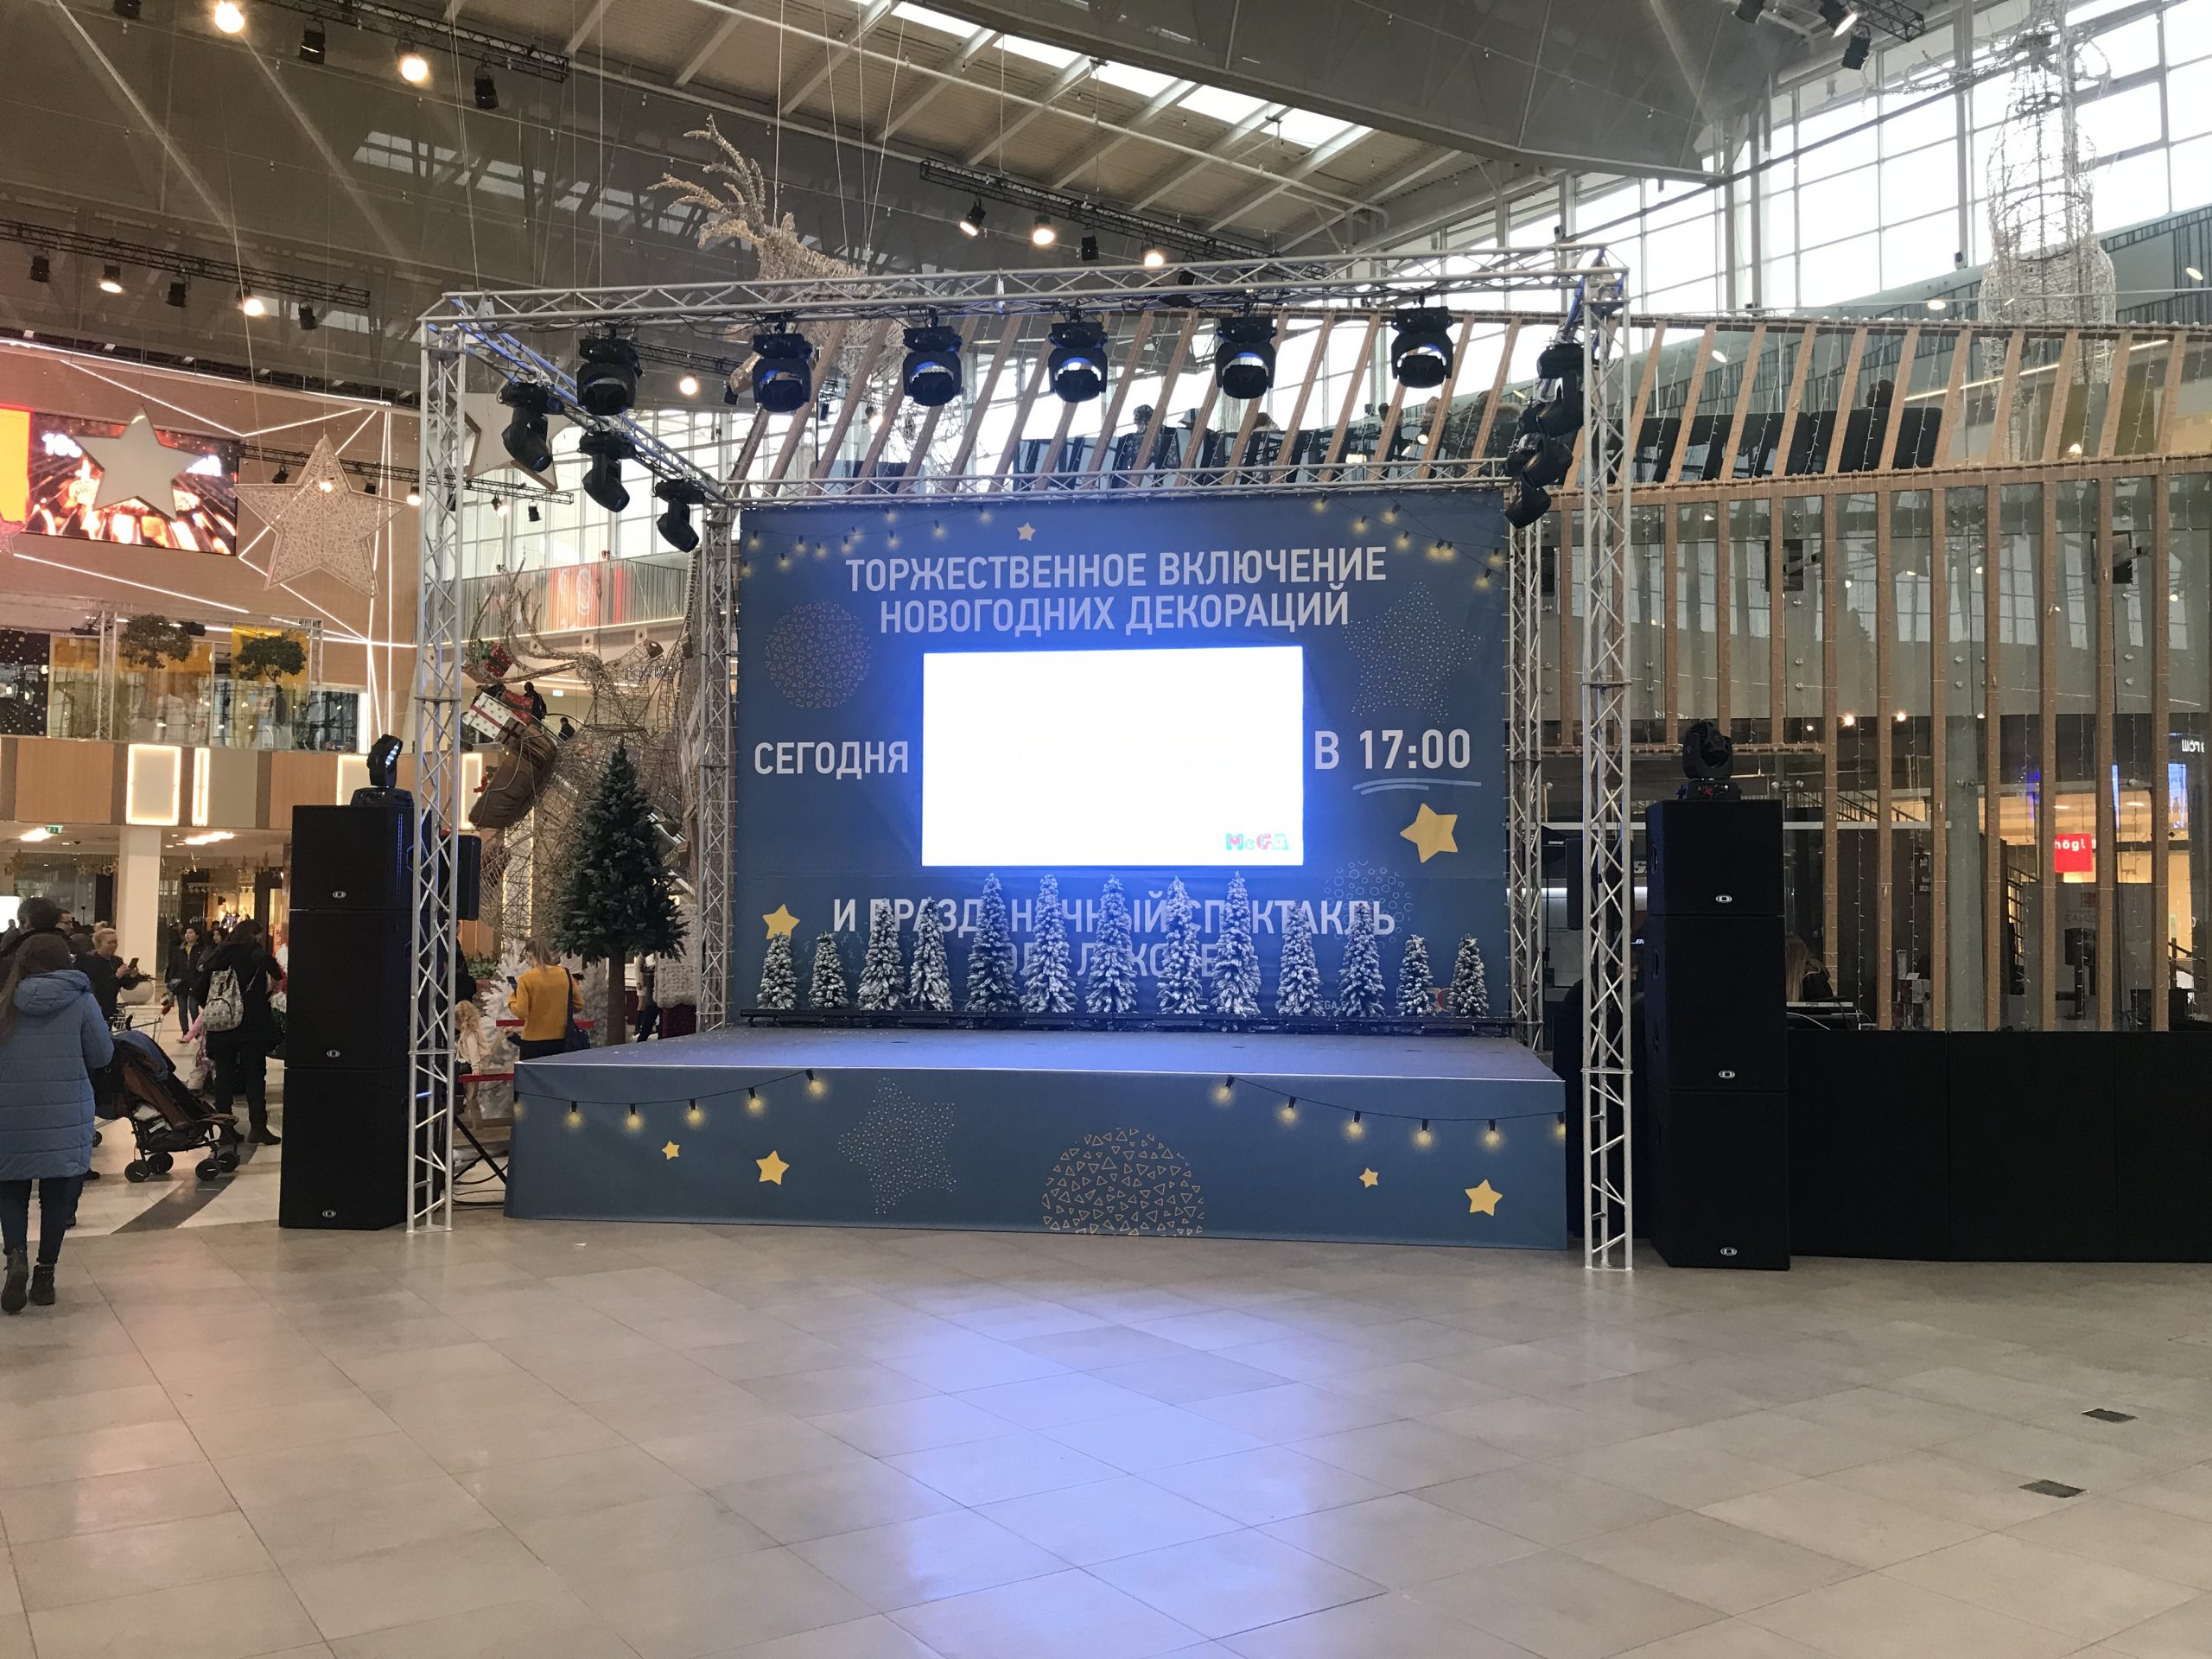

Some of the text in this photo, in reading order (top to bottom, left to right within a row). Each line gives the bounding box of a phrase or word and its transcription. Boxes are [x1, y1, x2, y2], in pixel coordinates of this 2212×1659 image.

[845, 546, 1387, 592] ТОРЖЕСТВЕННОЕ ВКЛЮЧЕНИЕ
[880, 582, 1349, 638] НОВОГОДНИХ ДЕКОРАЦИЙ
[754, 728, 1471, 780] СЕГОДНЯ В 17:00
[834, 899, 856, 932] И
